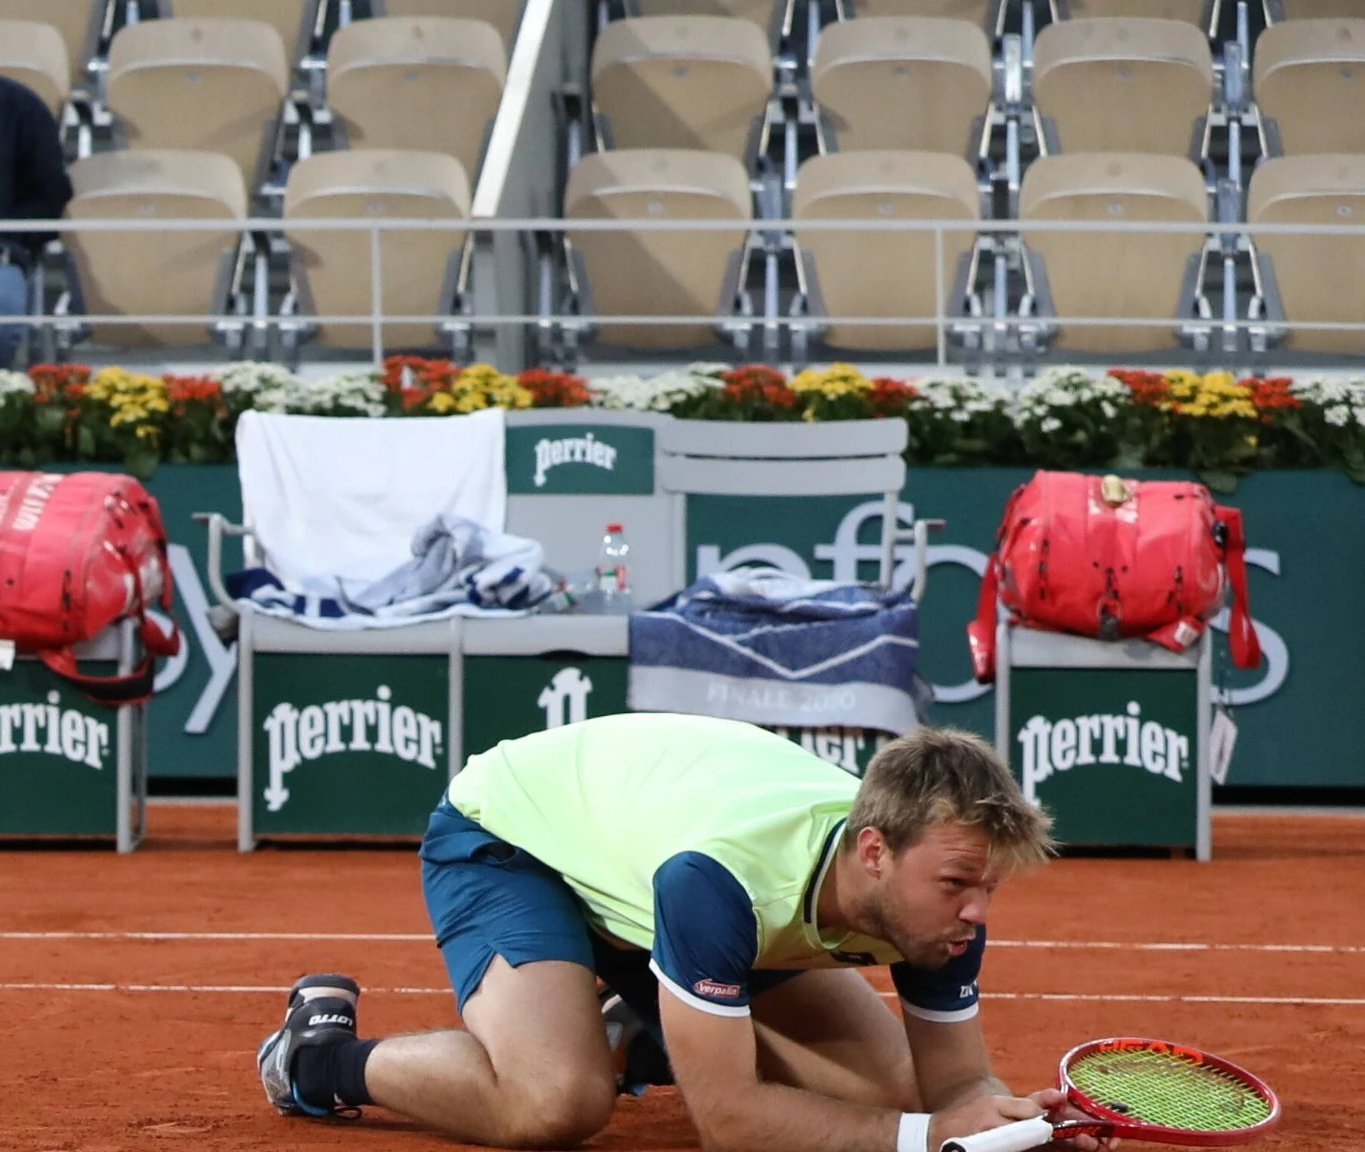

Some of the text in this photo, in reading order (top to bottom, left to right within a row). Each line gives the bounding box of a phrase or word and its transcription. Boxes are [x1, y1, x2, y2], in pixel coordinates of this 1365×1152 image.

[534, 432, 617, 486] perrier
[263, 686, 443, 812] perrier
[1018, 701, 1189, 806] perrier
